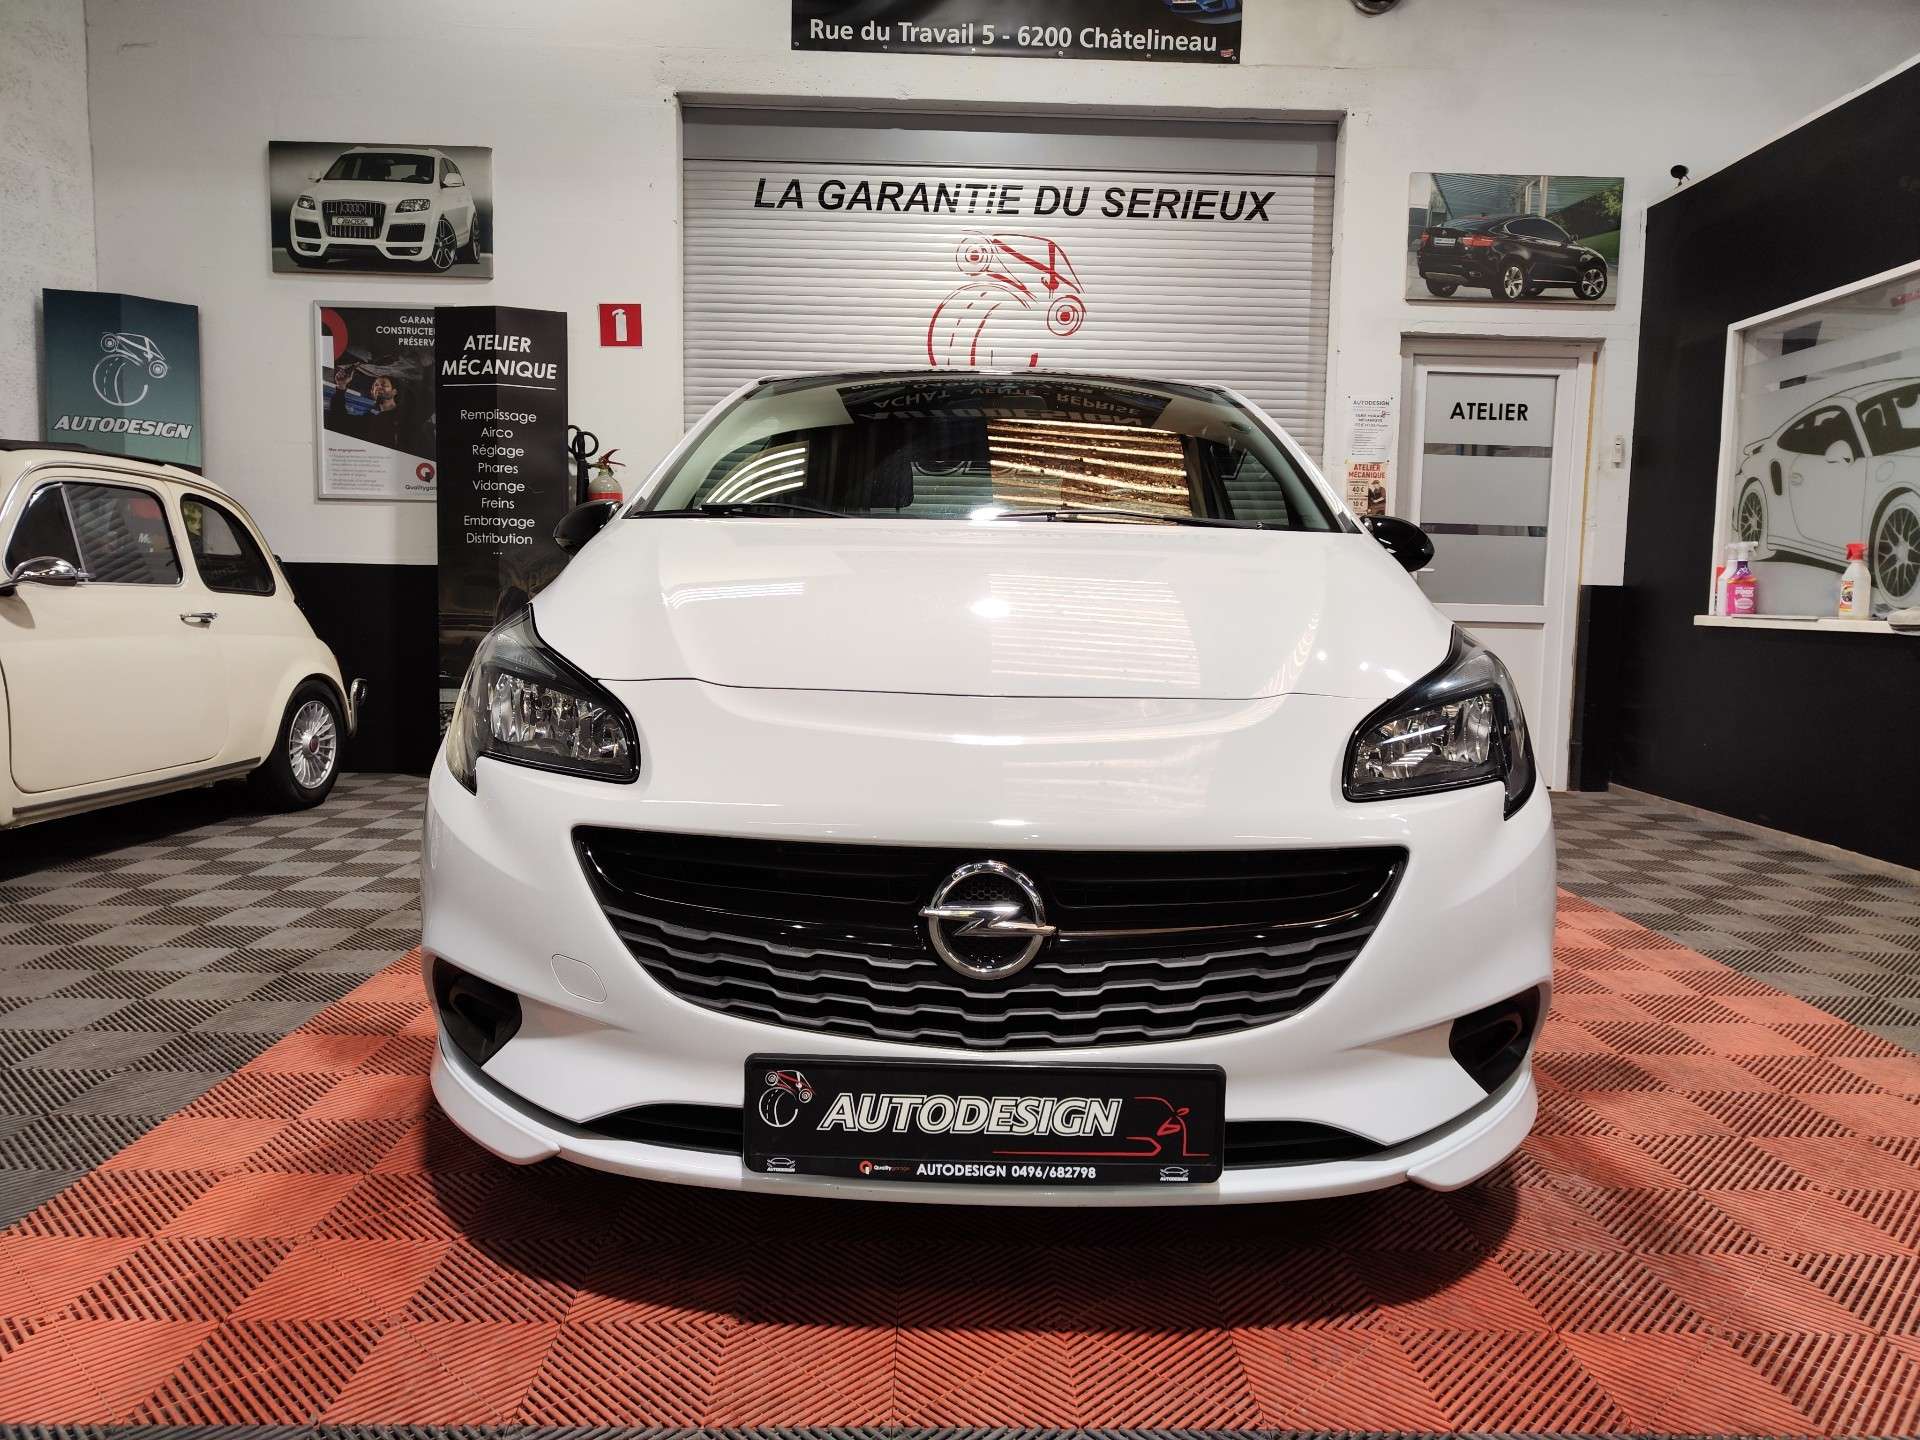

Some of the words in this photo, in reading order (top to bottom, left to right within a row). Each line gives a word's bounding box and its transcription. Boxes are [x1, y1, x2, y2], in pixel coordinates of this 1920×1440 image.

[810, 18, 854, 41] Rue
[861, 21, 891, 42] du
[898, 21, 974, 45] Travail
[982, 24, 996, 45] 5
[1017, 26, 1073, 48] 6200
[1079, 27, 1218, 53] Châtelineau
[754, 177, 804, 210] LA
[817, 179, 1024, 216] GARANTIE
[1034, 184, 1089, 217] DU
[1101, 188, 1277, 223] SERIEUX
[400, 315, 435, 325] GARAN
[463, 334, 532, 353] ATELIER
[441, 354, 558, 380] MÉCANIQUE
[460, 408, 537, 424] Remplissage
[1449, 401, 1530, 422] ATELIER
[53, 414, 193, 440] AUTODESIGN
[480, 426, 515, 439] Airco
[472, 444, 526, 459] Réglage
[478, 462, 520, 475] Phares
[1353, 463, 1381, 472] ATELIER
[472, 480, 526, 494] Vidange
[481, 497, 515, 510] Freins
[464, 515, 536, 530] Embrayage
[466, 532, 534, 546] Distribution
[817, 1092, 1123, 1138] AUTODESIGN
[916, 1162, 1008, 1178] AUTODESIGN
[1011, 1164, 1097, 1181] 0496/682798
